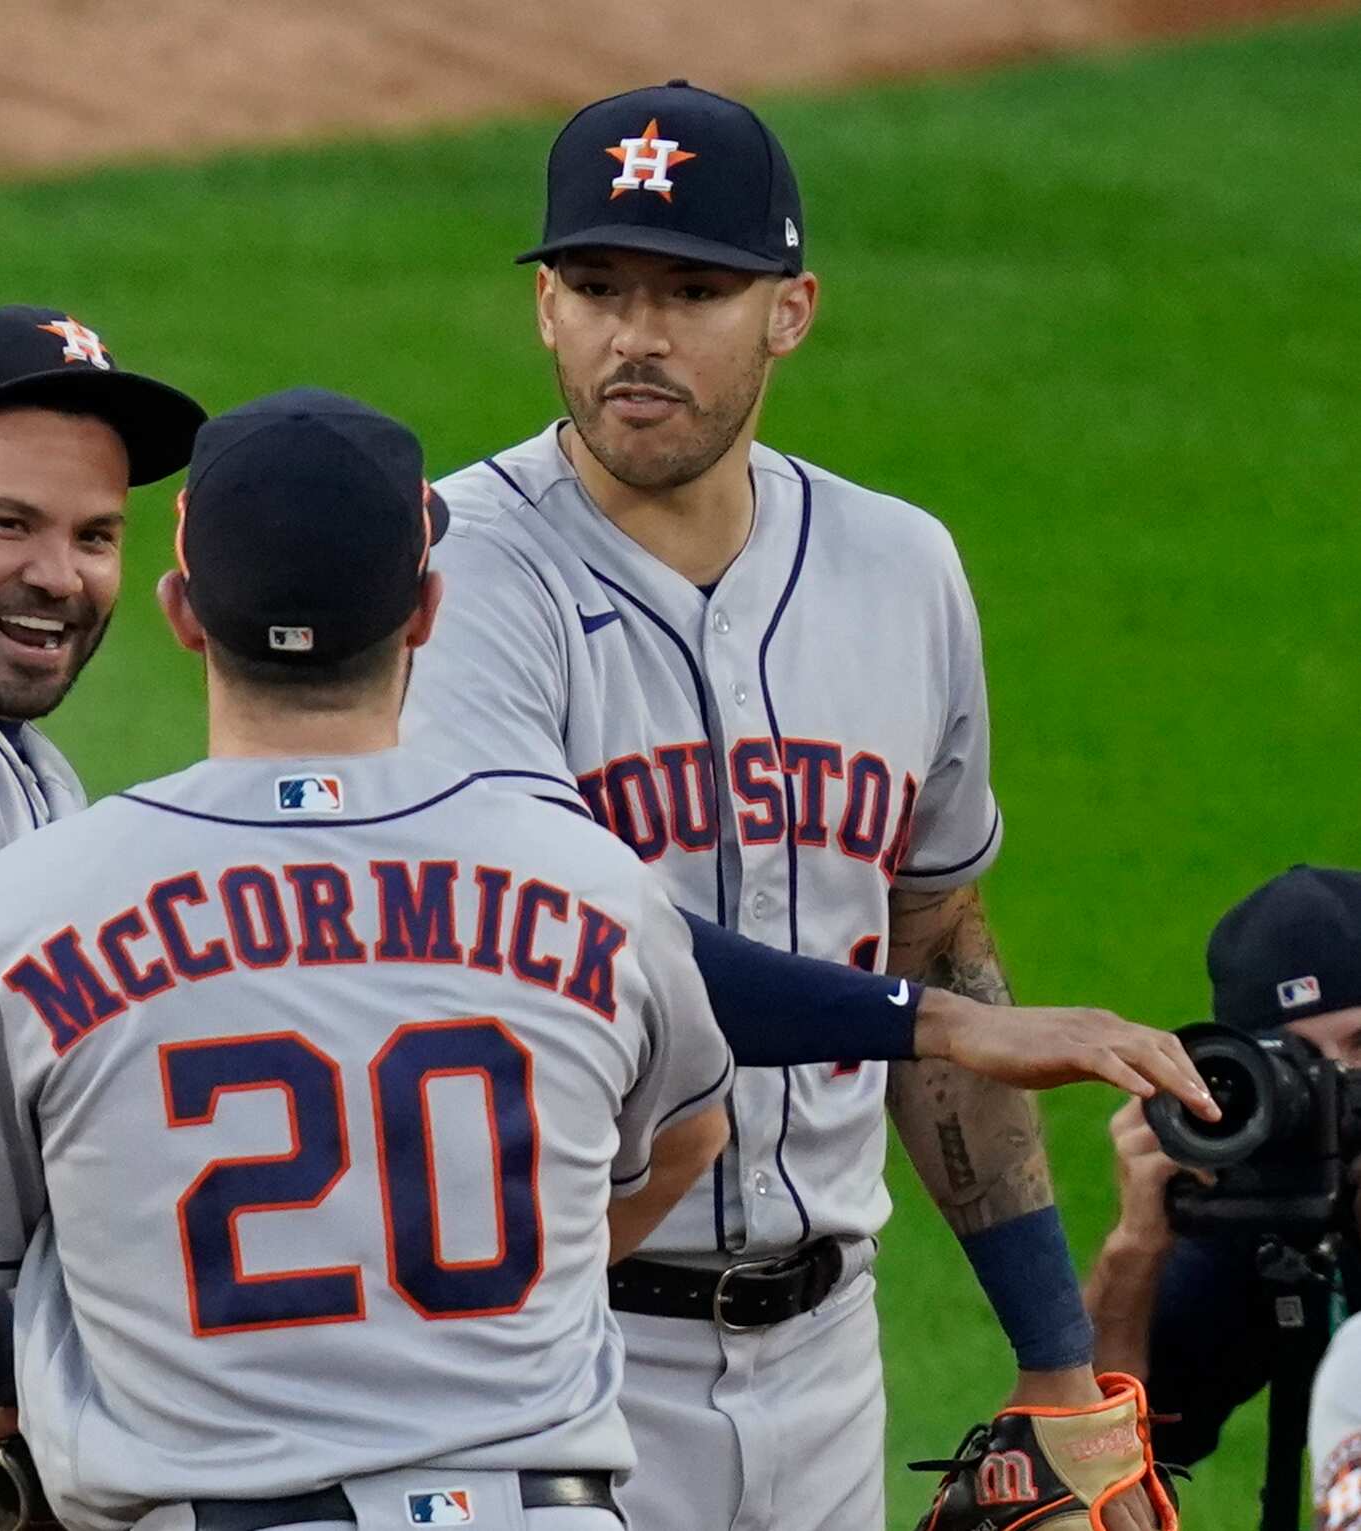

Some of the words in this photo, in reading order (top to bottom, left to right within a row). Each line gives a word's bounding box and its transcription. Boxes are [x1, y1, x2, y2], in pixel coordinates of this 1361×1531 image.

[611, 137, 680, 192] H
[50, 319, 111, 371] H
[575, 736, 918, 886] OUSTO
[157, 1015, 546, 1338] 20
